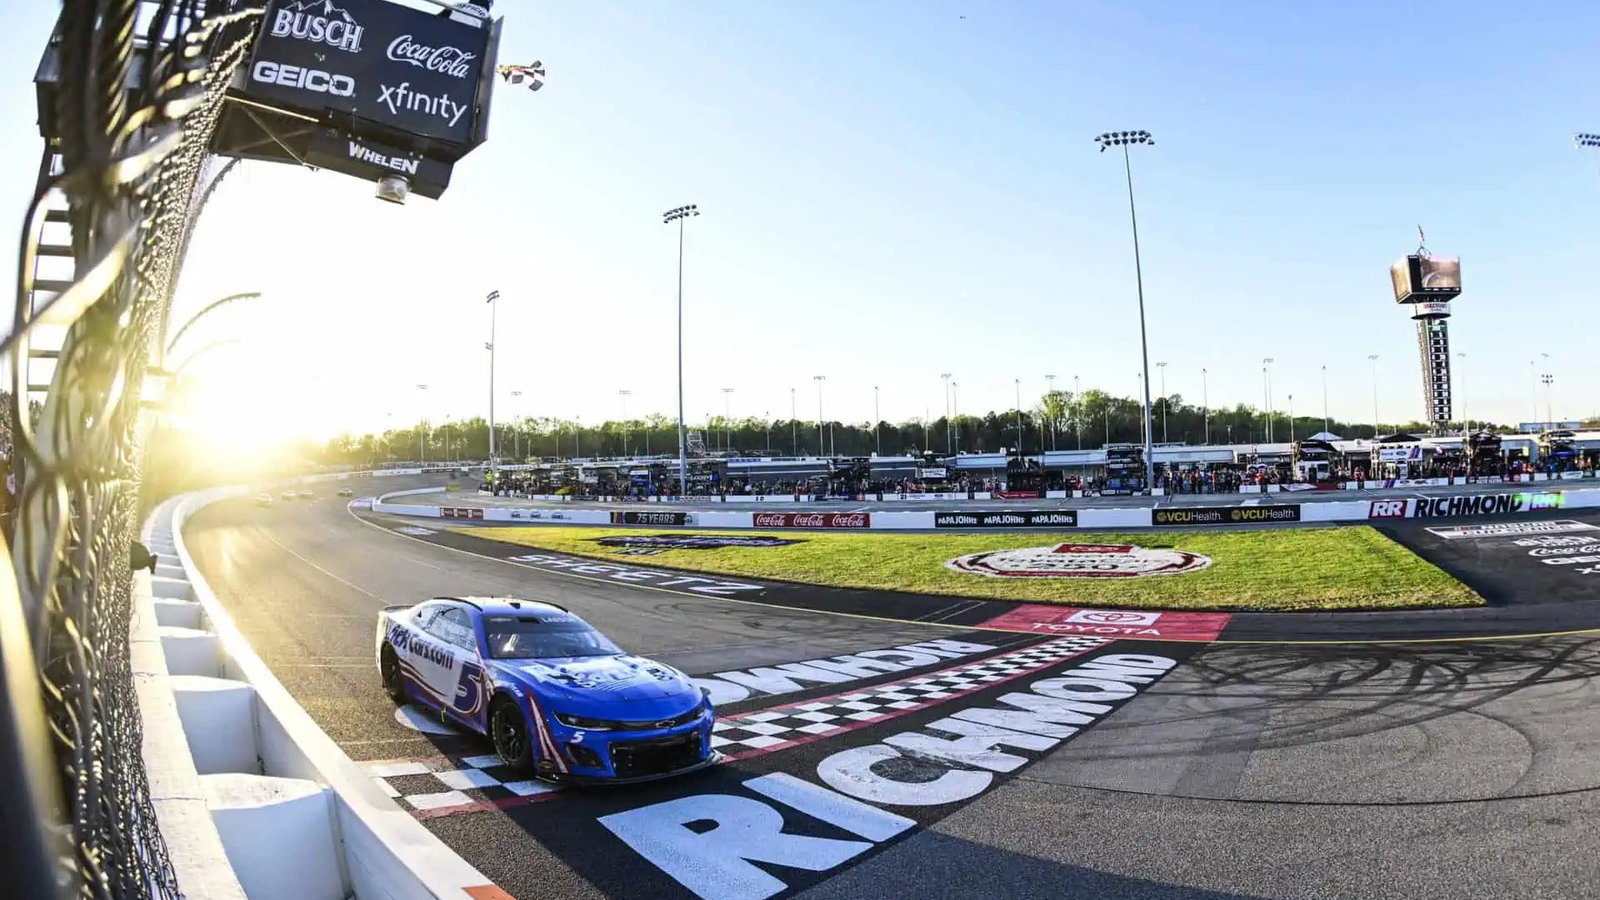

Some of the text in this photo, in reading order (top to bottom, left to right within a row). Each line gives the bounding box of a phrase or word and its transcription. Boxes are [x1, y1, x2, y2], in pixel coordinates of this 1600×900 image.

[271, 9, 364, 53] BUSCH
[253, 61, 356, 97] GEICO
[377, 82, 467, 127] xfinity
[648, 513, 675, 523] YEARS
[1372, 501, 1402, 517] RR
[1414, 494, 1524, 517] RICHMOND
[1031, 621, 1162, 636] TOYOTA
[454, 660, 482, 714] 5
[570, 730, 586, 744] 5
[596, 654, 1177, 900] RICHMOND
